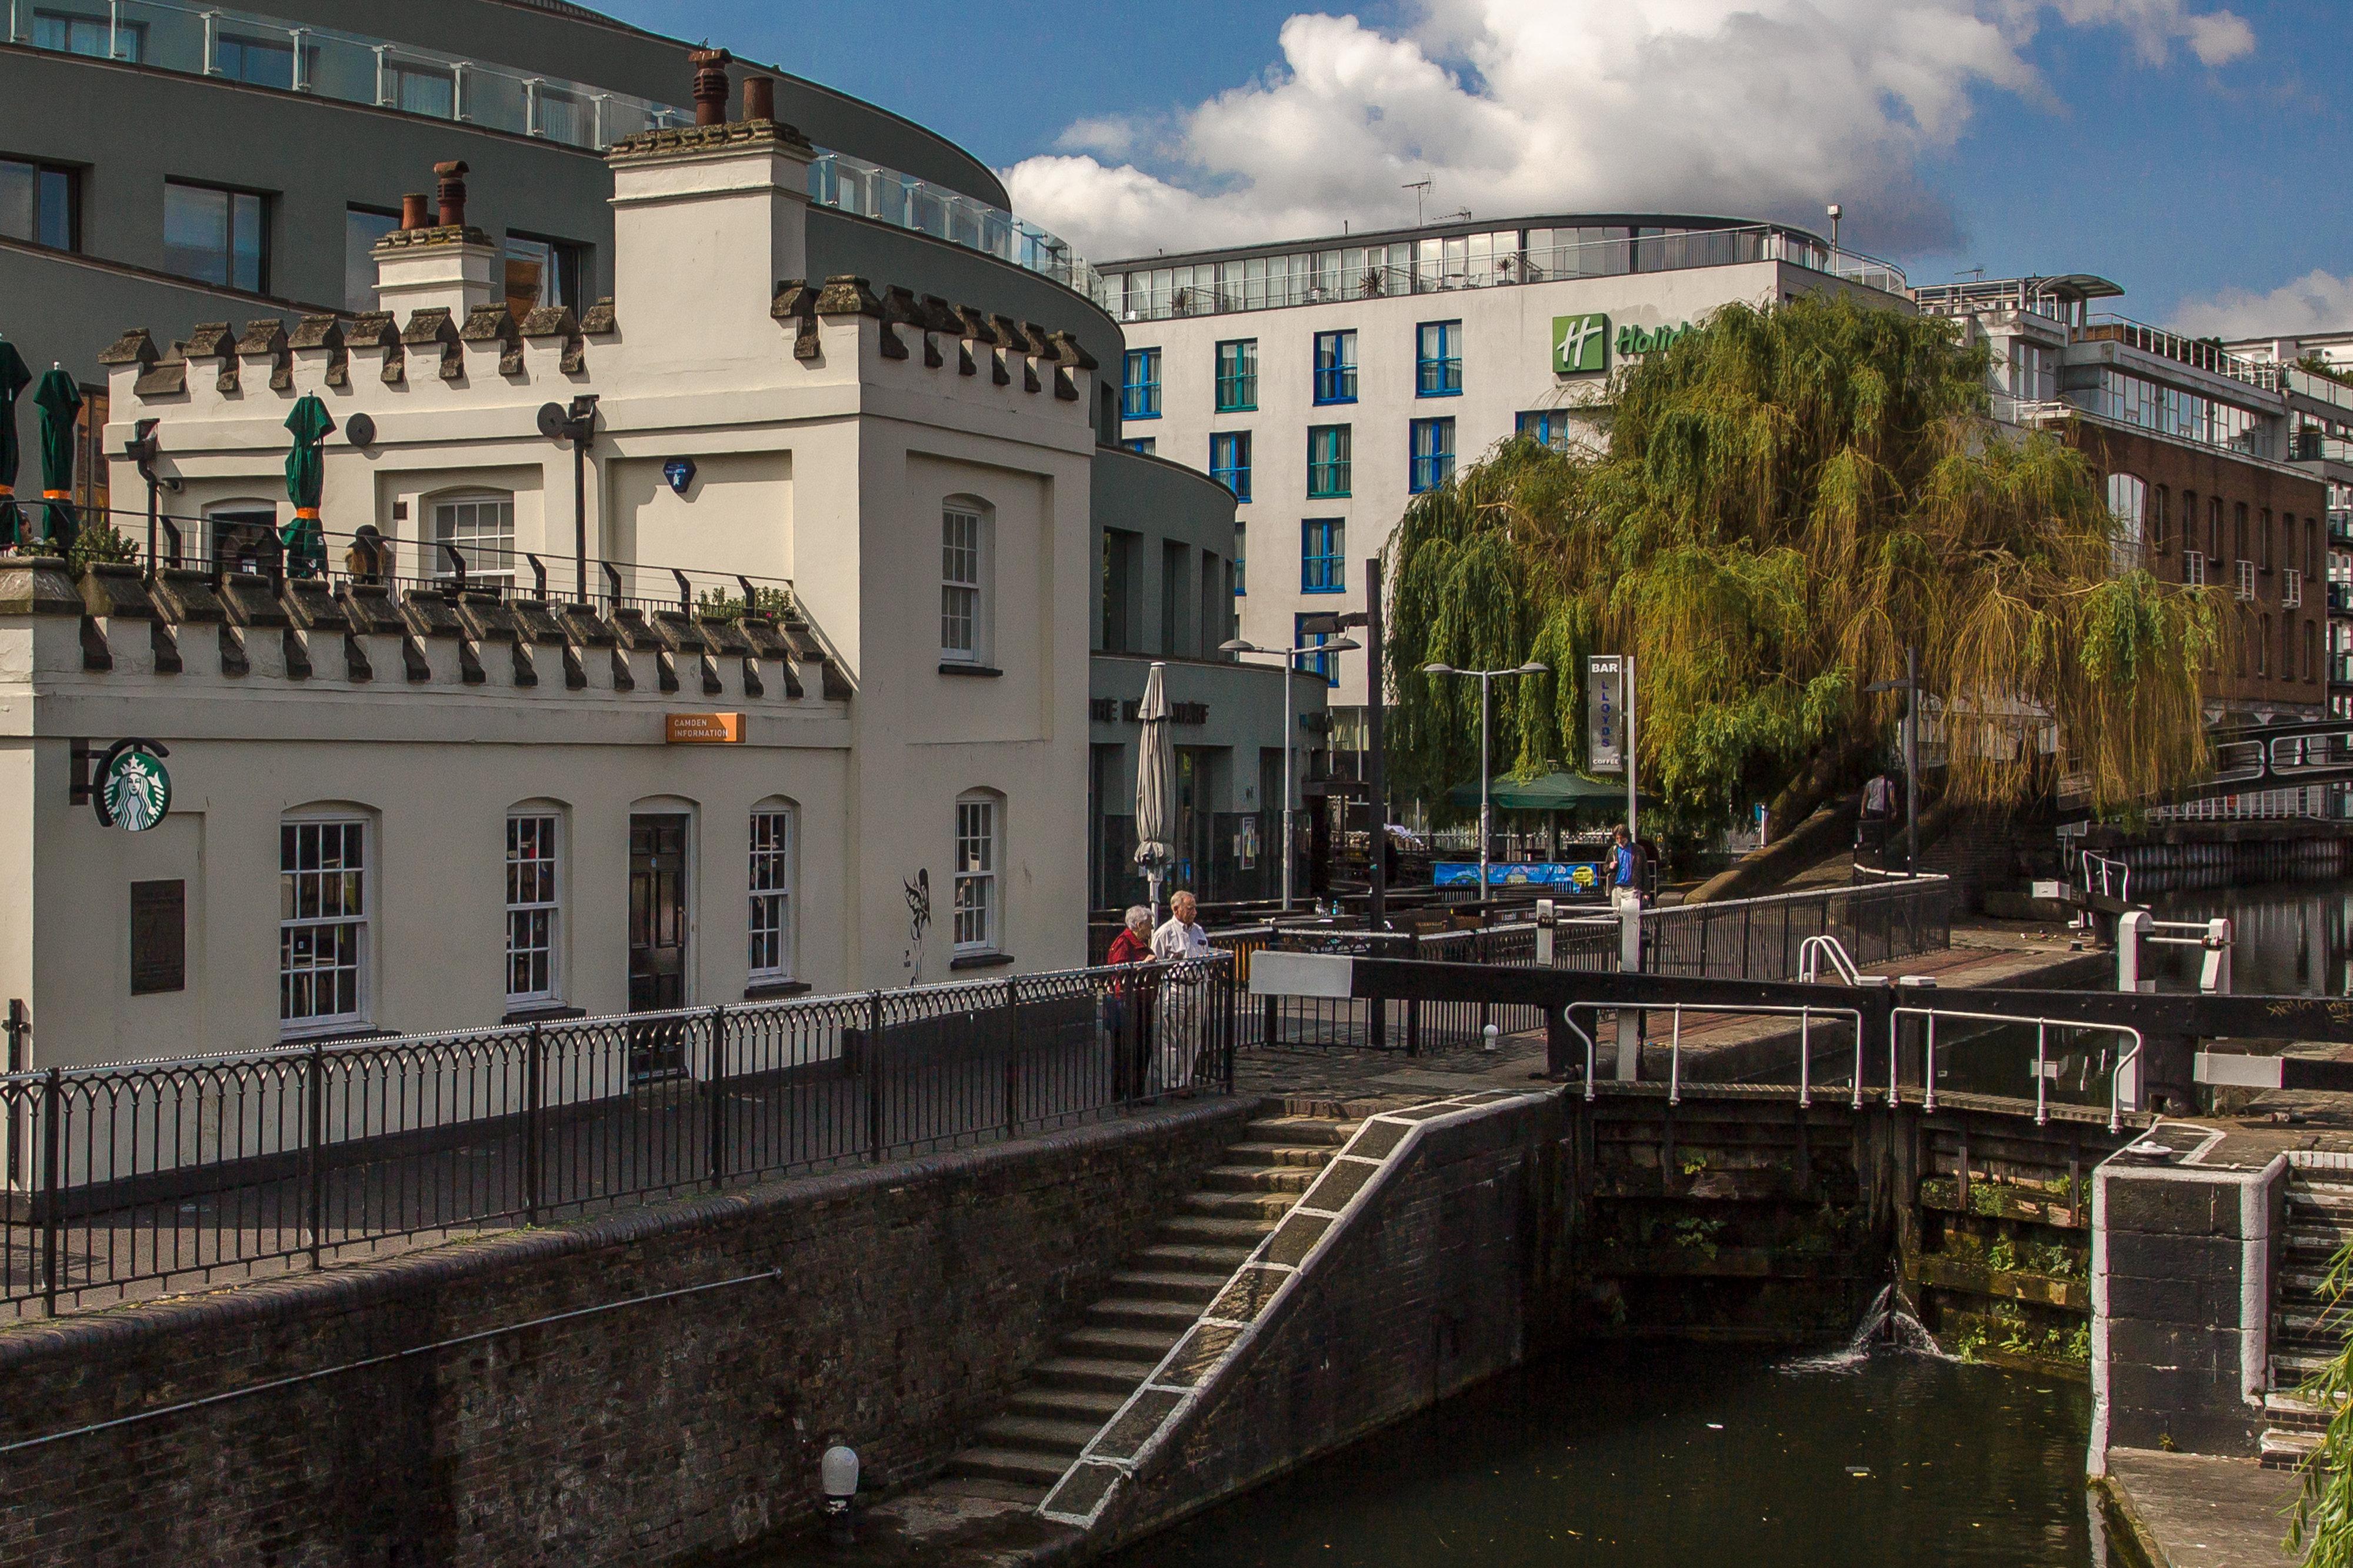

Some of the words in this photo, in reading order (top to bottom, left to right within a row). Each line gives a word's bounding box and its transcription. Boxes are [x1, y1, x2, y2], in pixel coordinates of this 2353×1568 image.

[1615, 321, 1689, 353] Holid
[1592, 663, 1618, 673] BAR
[1601, 680, 1610, 747] LLOYDS
[674, 719, 707, 727] CAMDEN
[675, 729, 728, 738] INFORMATION
